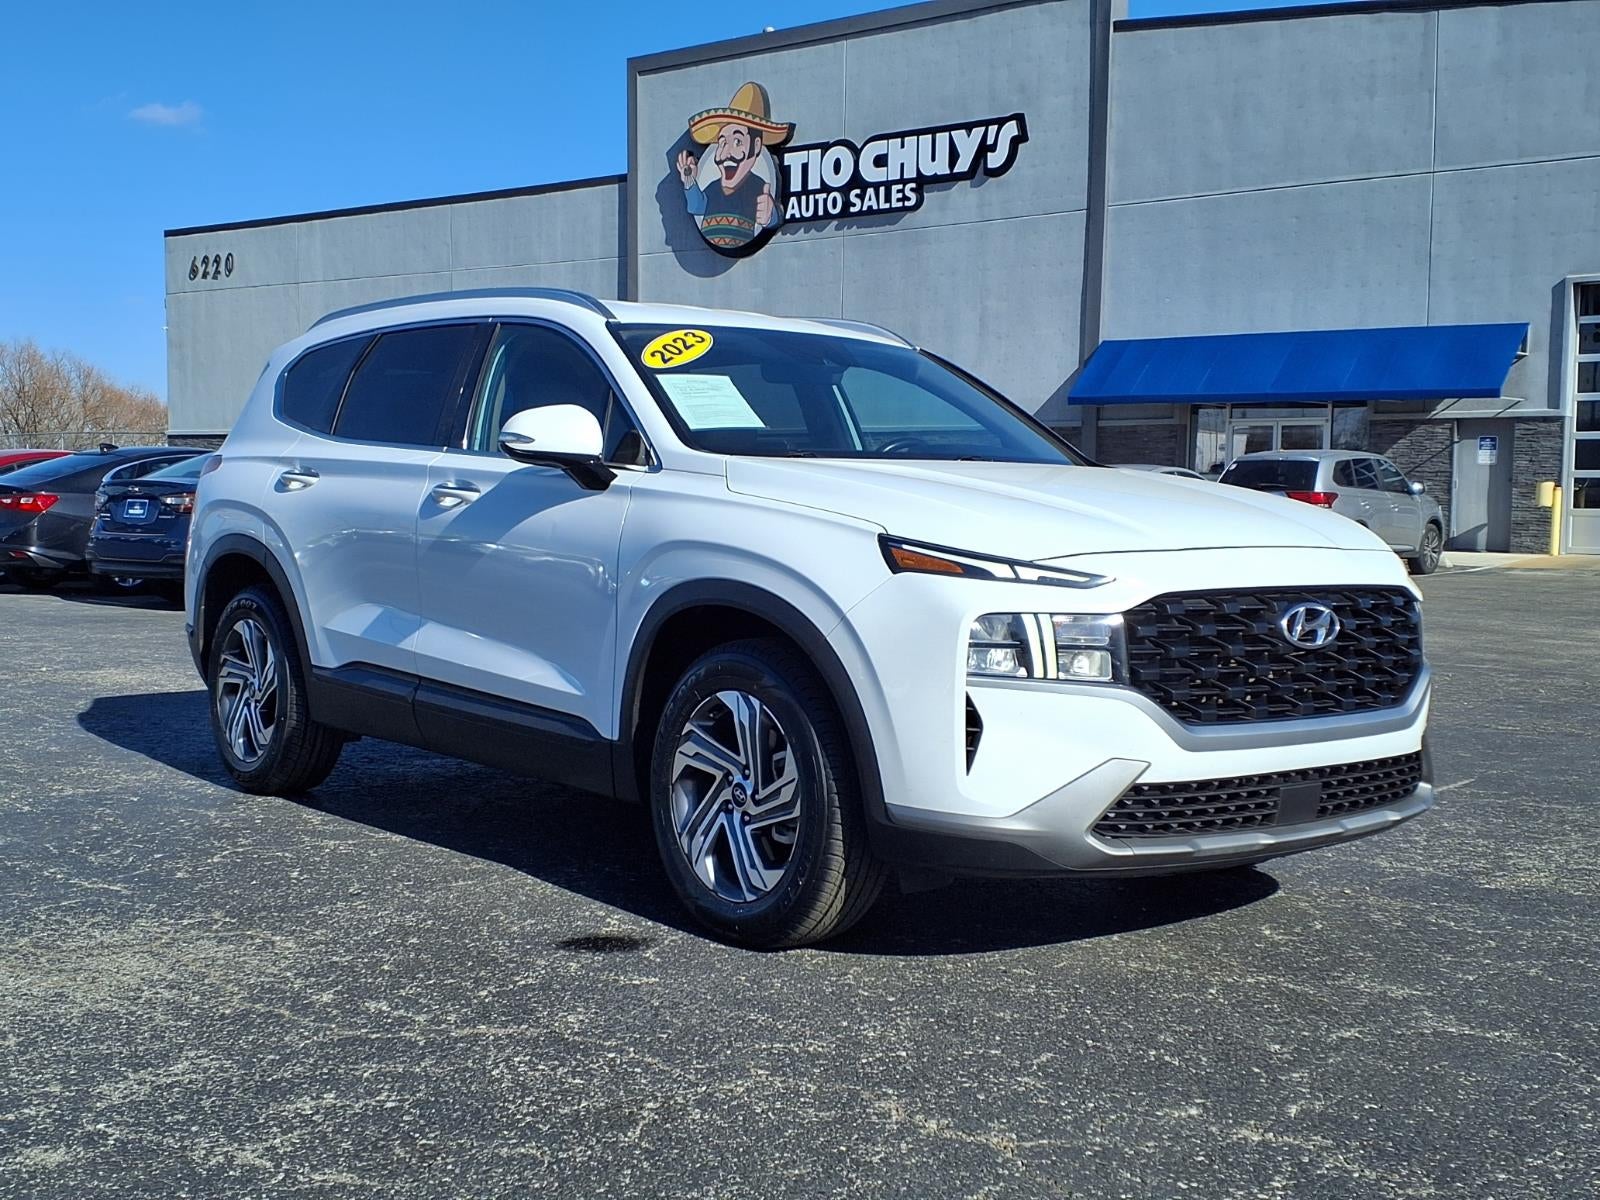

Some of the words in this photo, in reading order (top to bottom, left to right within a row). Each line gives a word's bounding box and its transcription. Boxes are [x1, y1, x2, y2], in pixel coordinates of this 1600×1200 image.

[784, 147, 854, 192] TIO
[859, 120, 1018, 183] CHUY'S
[785, 191, 843, 220] AUTO
[850, 182, 917, 212] SALES
[188, 252, 234, 281] 6220
[650, 331, 706, 365] 2023
